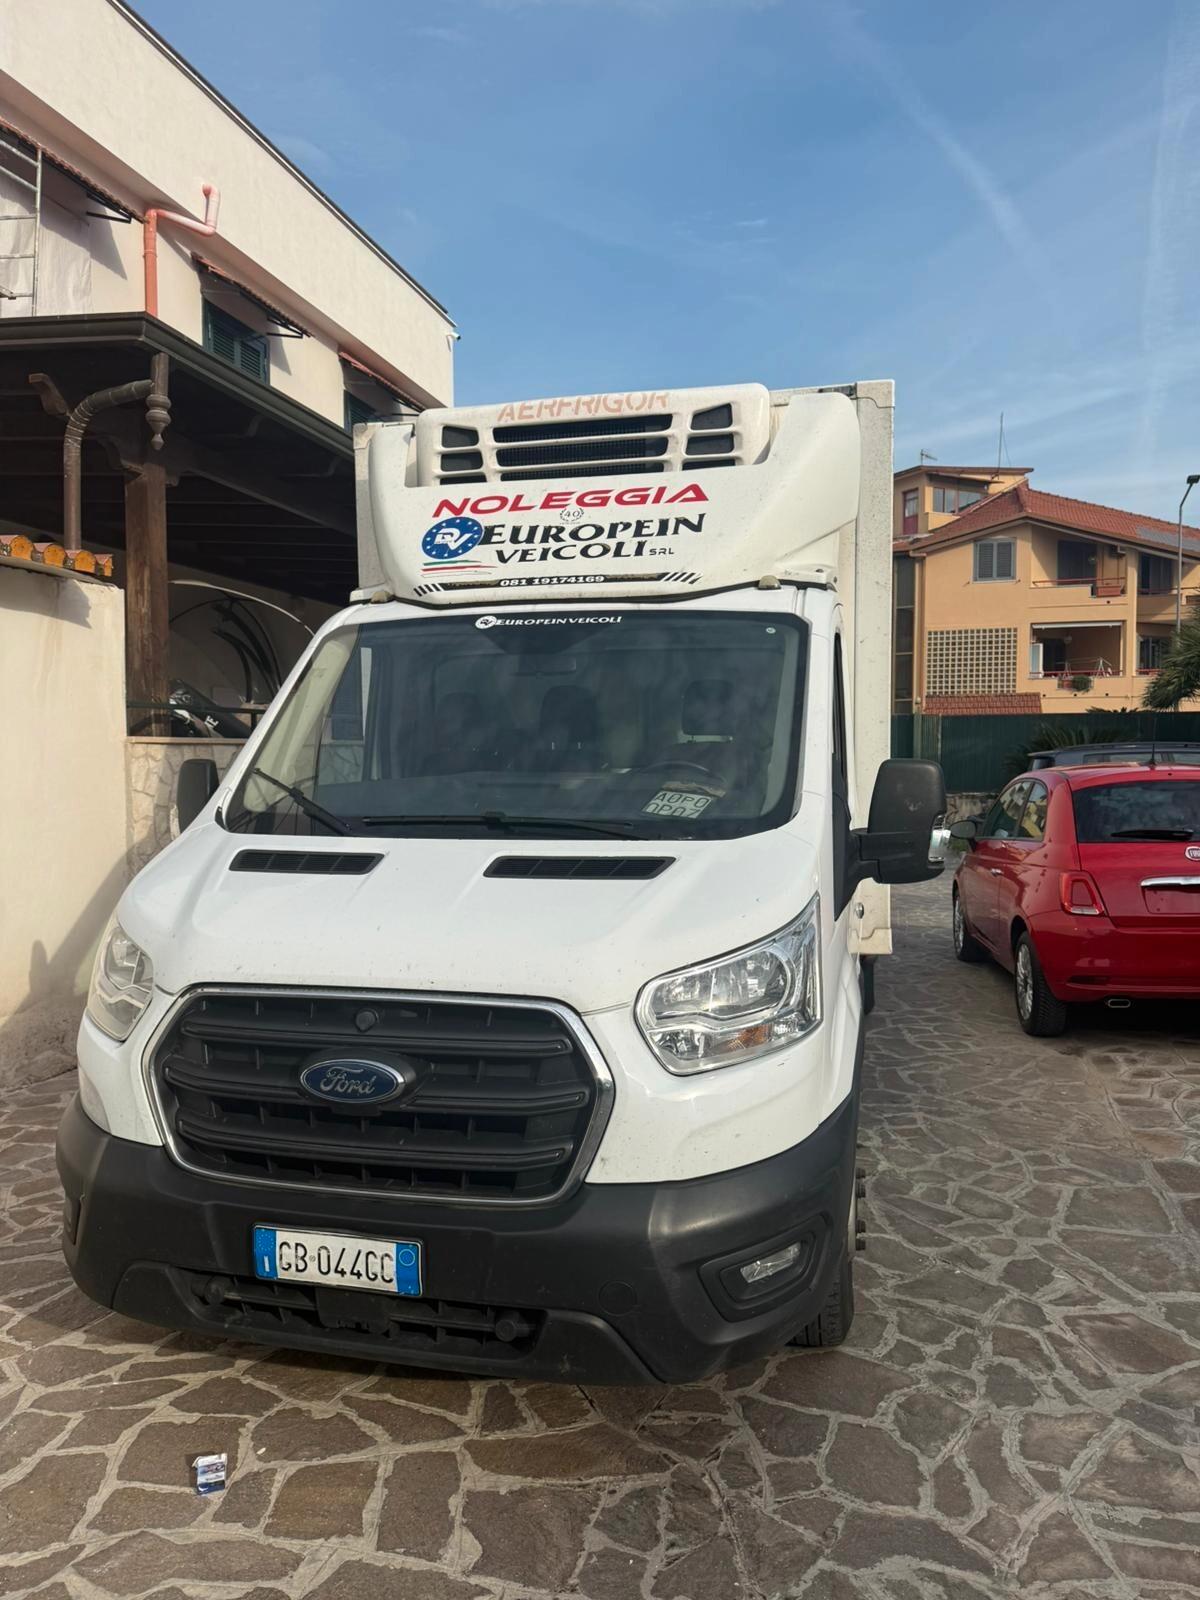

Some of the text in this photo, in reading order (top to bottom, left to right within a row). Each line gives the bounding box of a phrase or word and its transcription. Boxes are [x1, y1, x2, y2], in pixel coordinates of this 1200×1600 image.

[496, 392, 672, 422] AERFRIGOR
[432, 483, 709, 518] NOLEGGIA
[478, 512, 707, 545] EUROPEIN
[495, 539, 675, 565] VEICOLI SRL
[500, 578, 527, 587] 081
[496, 617, 567, 626] EUROPEIN
[569, 615, 623, 624] VEICOLI
[320, 1066, 378, 1095] Ford
